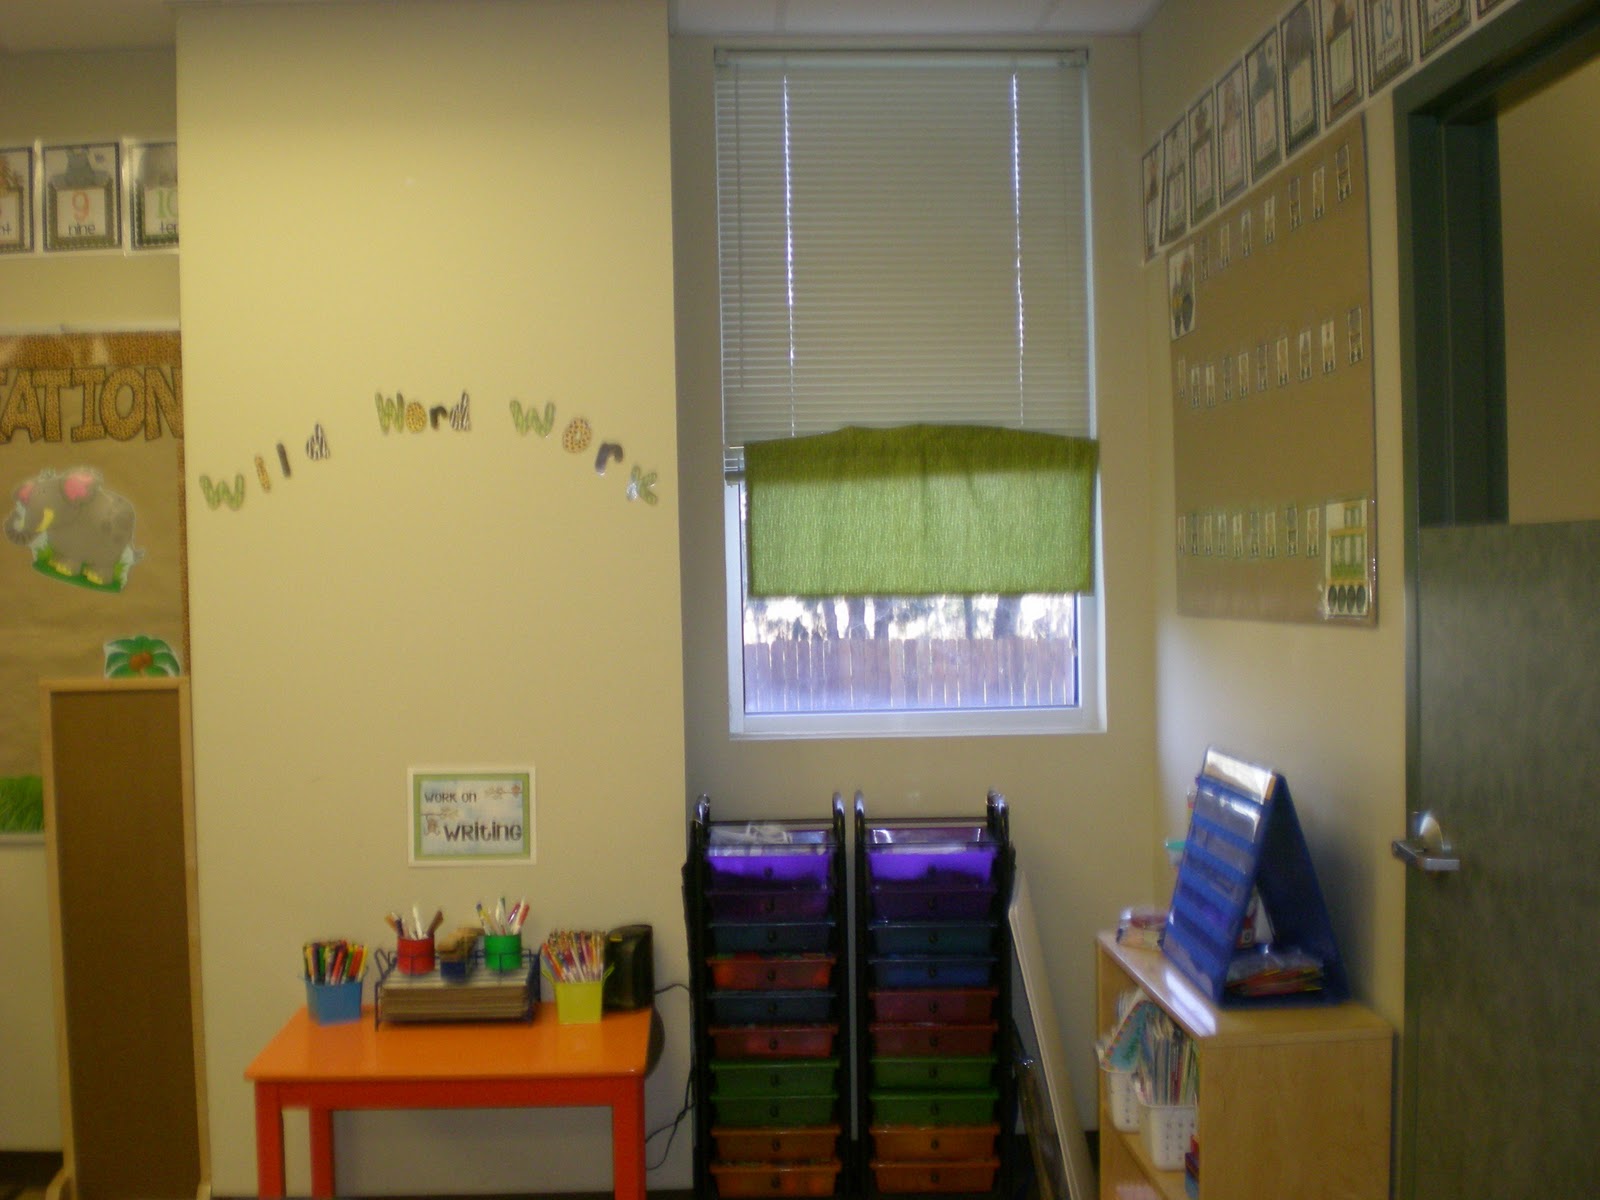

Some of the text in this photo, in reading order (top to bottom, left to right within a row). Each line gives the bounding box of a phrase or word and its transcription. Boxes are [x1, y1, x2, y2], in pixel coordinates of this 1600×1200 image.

[68, 222, 96, 236] nine
[71, 191, 90, 221] 9
[0, 366, 183, 444] ATION
[374, 389, 471, 435] Word
[509, 399, 659, 507] Work
